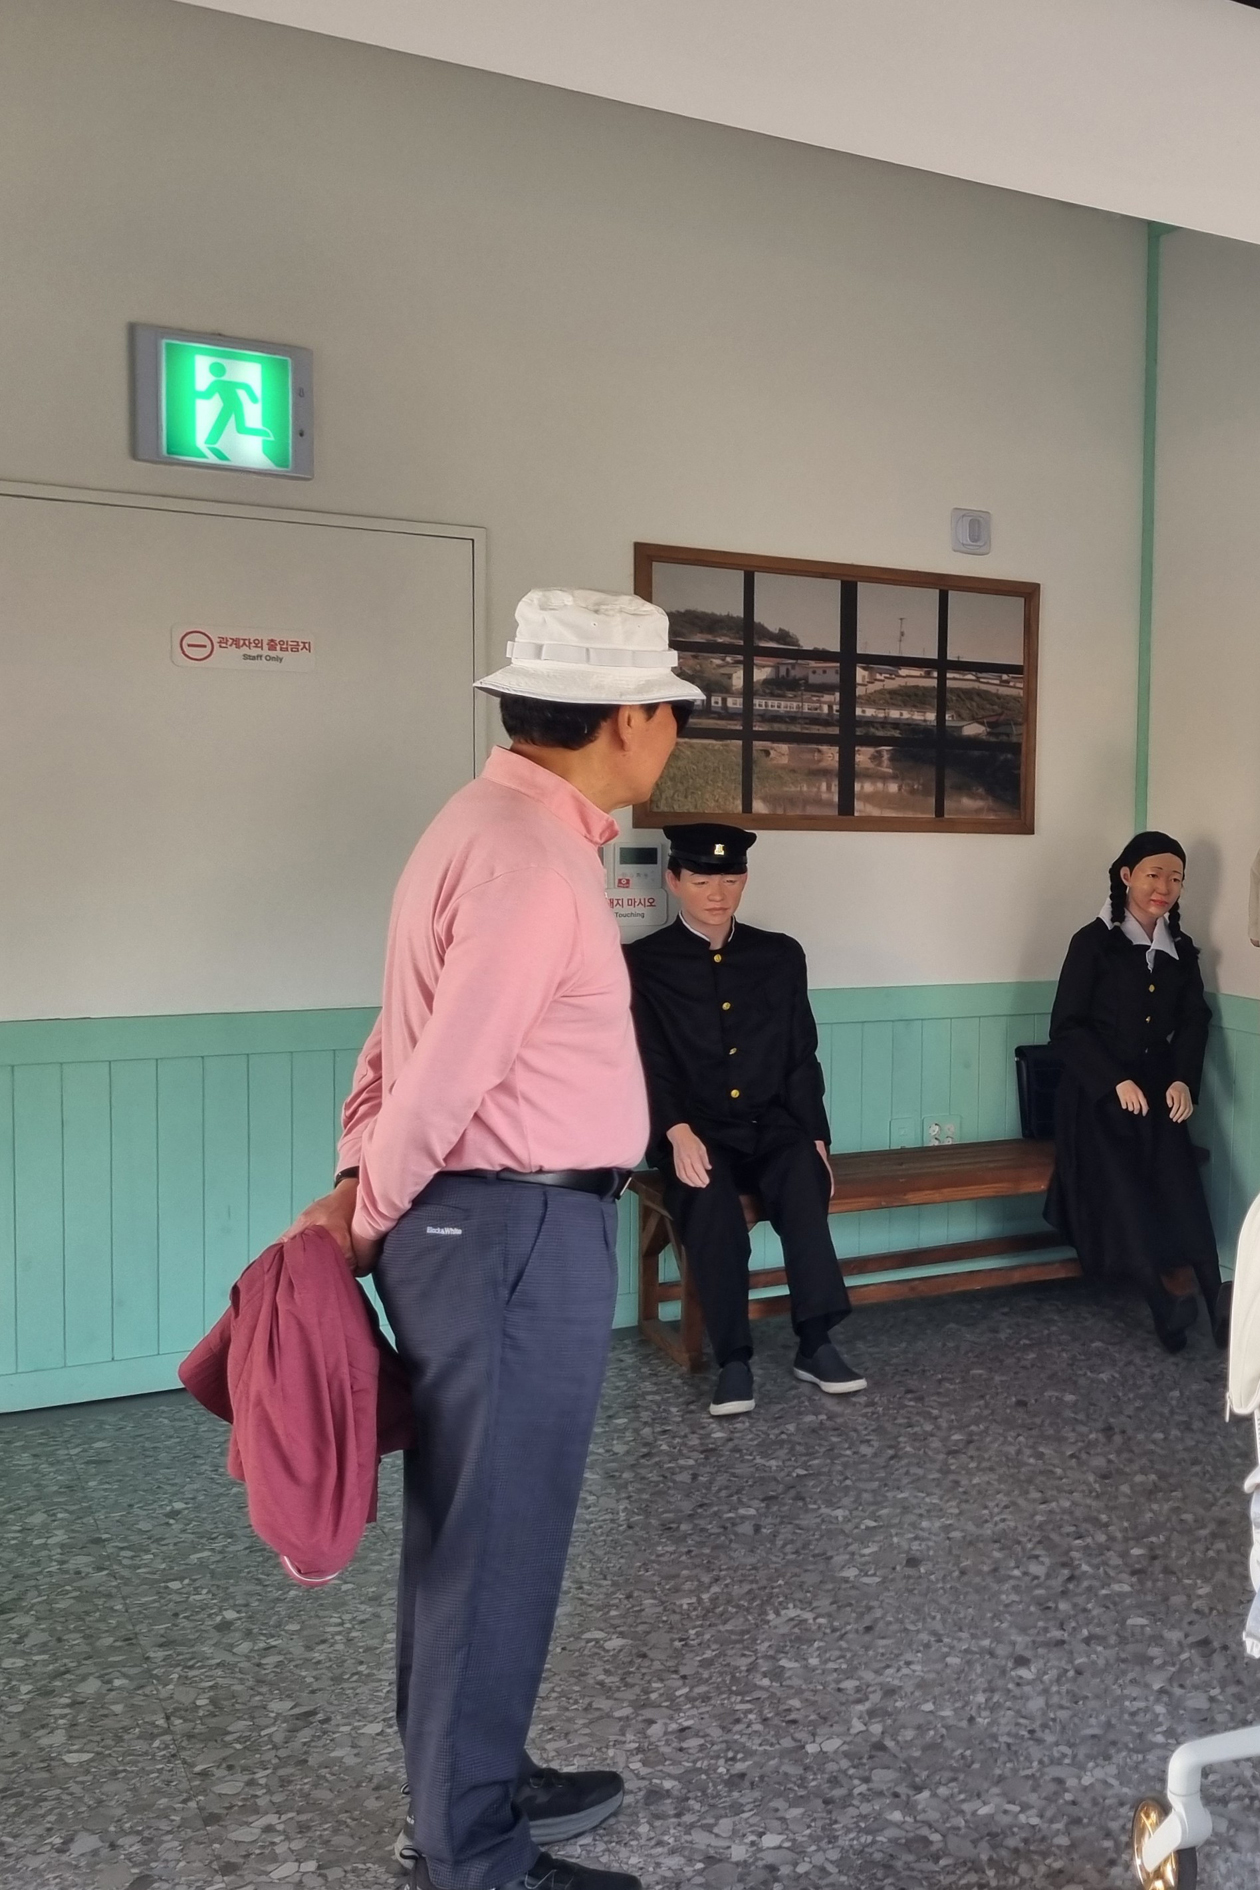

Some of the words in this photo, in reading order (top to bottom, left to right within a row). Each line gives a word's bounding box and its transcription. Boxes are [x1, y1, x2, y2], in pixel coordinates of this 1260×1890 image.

[216, 636, 264, 651] 관계자외
[266, 638, 312, 653] 출입금지
[242, 653, 263, 662] Staff
[264, 654, 283, 664] Only
[627, 897, 656, 908] 마시오
[614, 911, 645, 919] Touching
